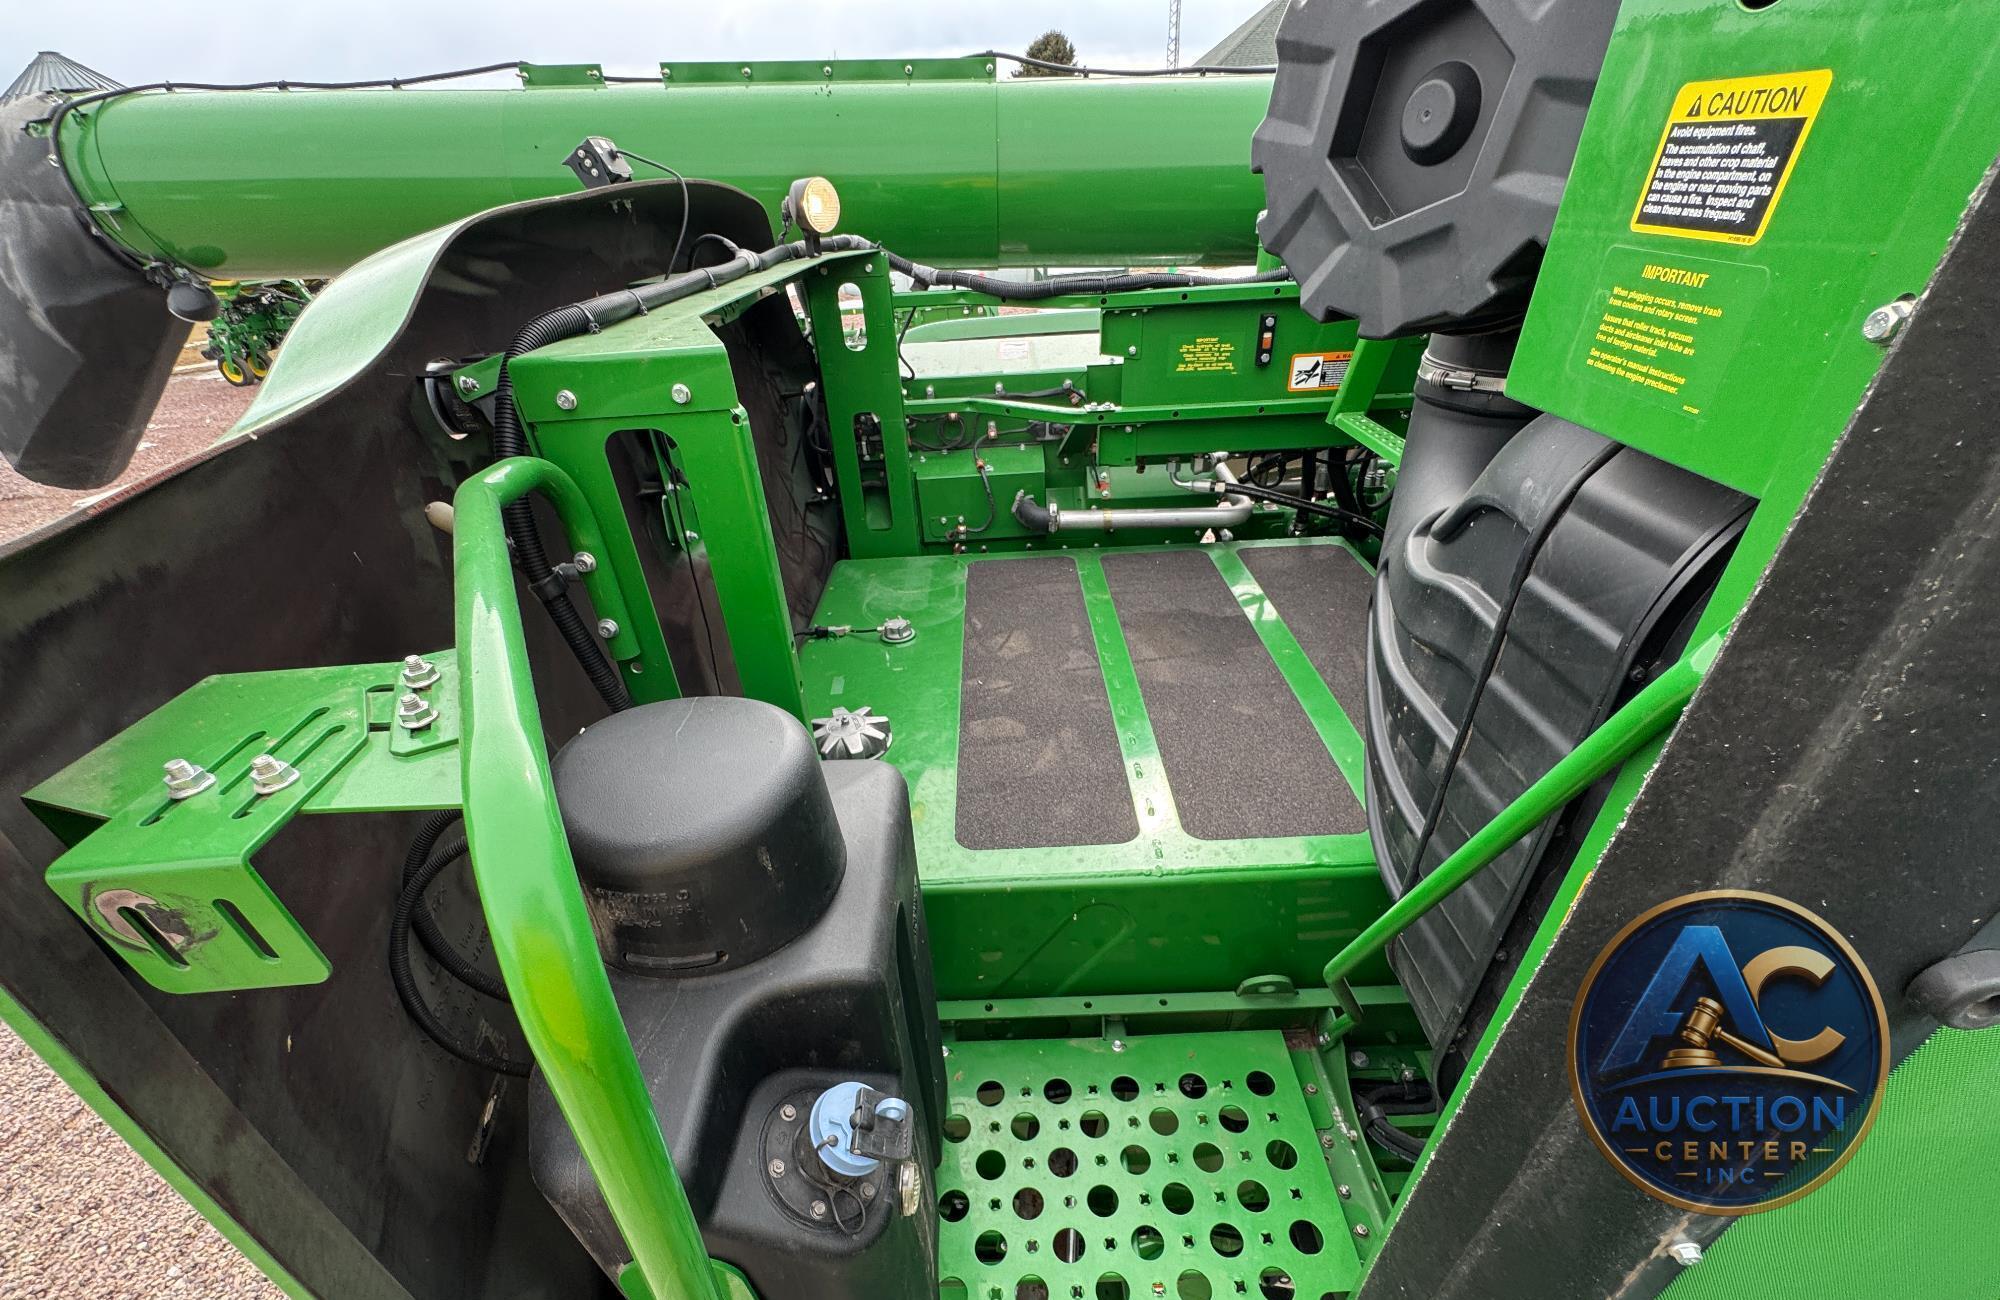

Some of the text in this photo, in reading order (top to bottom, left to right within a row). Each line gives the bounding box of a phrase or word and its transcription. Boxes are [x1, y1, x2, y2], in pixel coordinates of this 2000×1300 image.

[1708, 86, 1807, 116] CAUTION
[1671, 124, 1756, 139] Avoid equipment fires.
[1666, 142, 1766, 156] The accumulation of chaff,
[1660, 156, 1779, 170] leaves and other crop material
[1655, 167, 1772, 183] in the engine compartment, on
[1651, 180, 1772, 198] the engine or near moving parts
[1647, 193, 1756, 208] can cause a fire. Inspect and
[1643, 203, 1746, 223] clean these areas frequently.
[1642, 264, 1709, 288] IMPORTANT
[1609, 297, 1698, 324] from coolers and rotary screen.
[1614, 286, 1722, 317] When plugging occurs, remove trash
[1622, 318, 1634, 327] that
[1634, 322, 1650, 331] roller
[1668, 331, 1693, 343] vacuum
[1614, 329, 1626, 337] and
[1668, 342, 1683, 352] tube
[1683, 347, 1695, 355] are
[1616, 367, 1625, 376] the
[1627, 361, 1649, 373] manual
[1648, 366, 1686, 385] instructions
